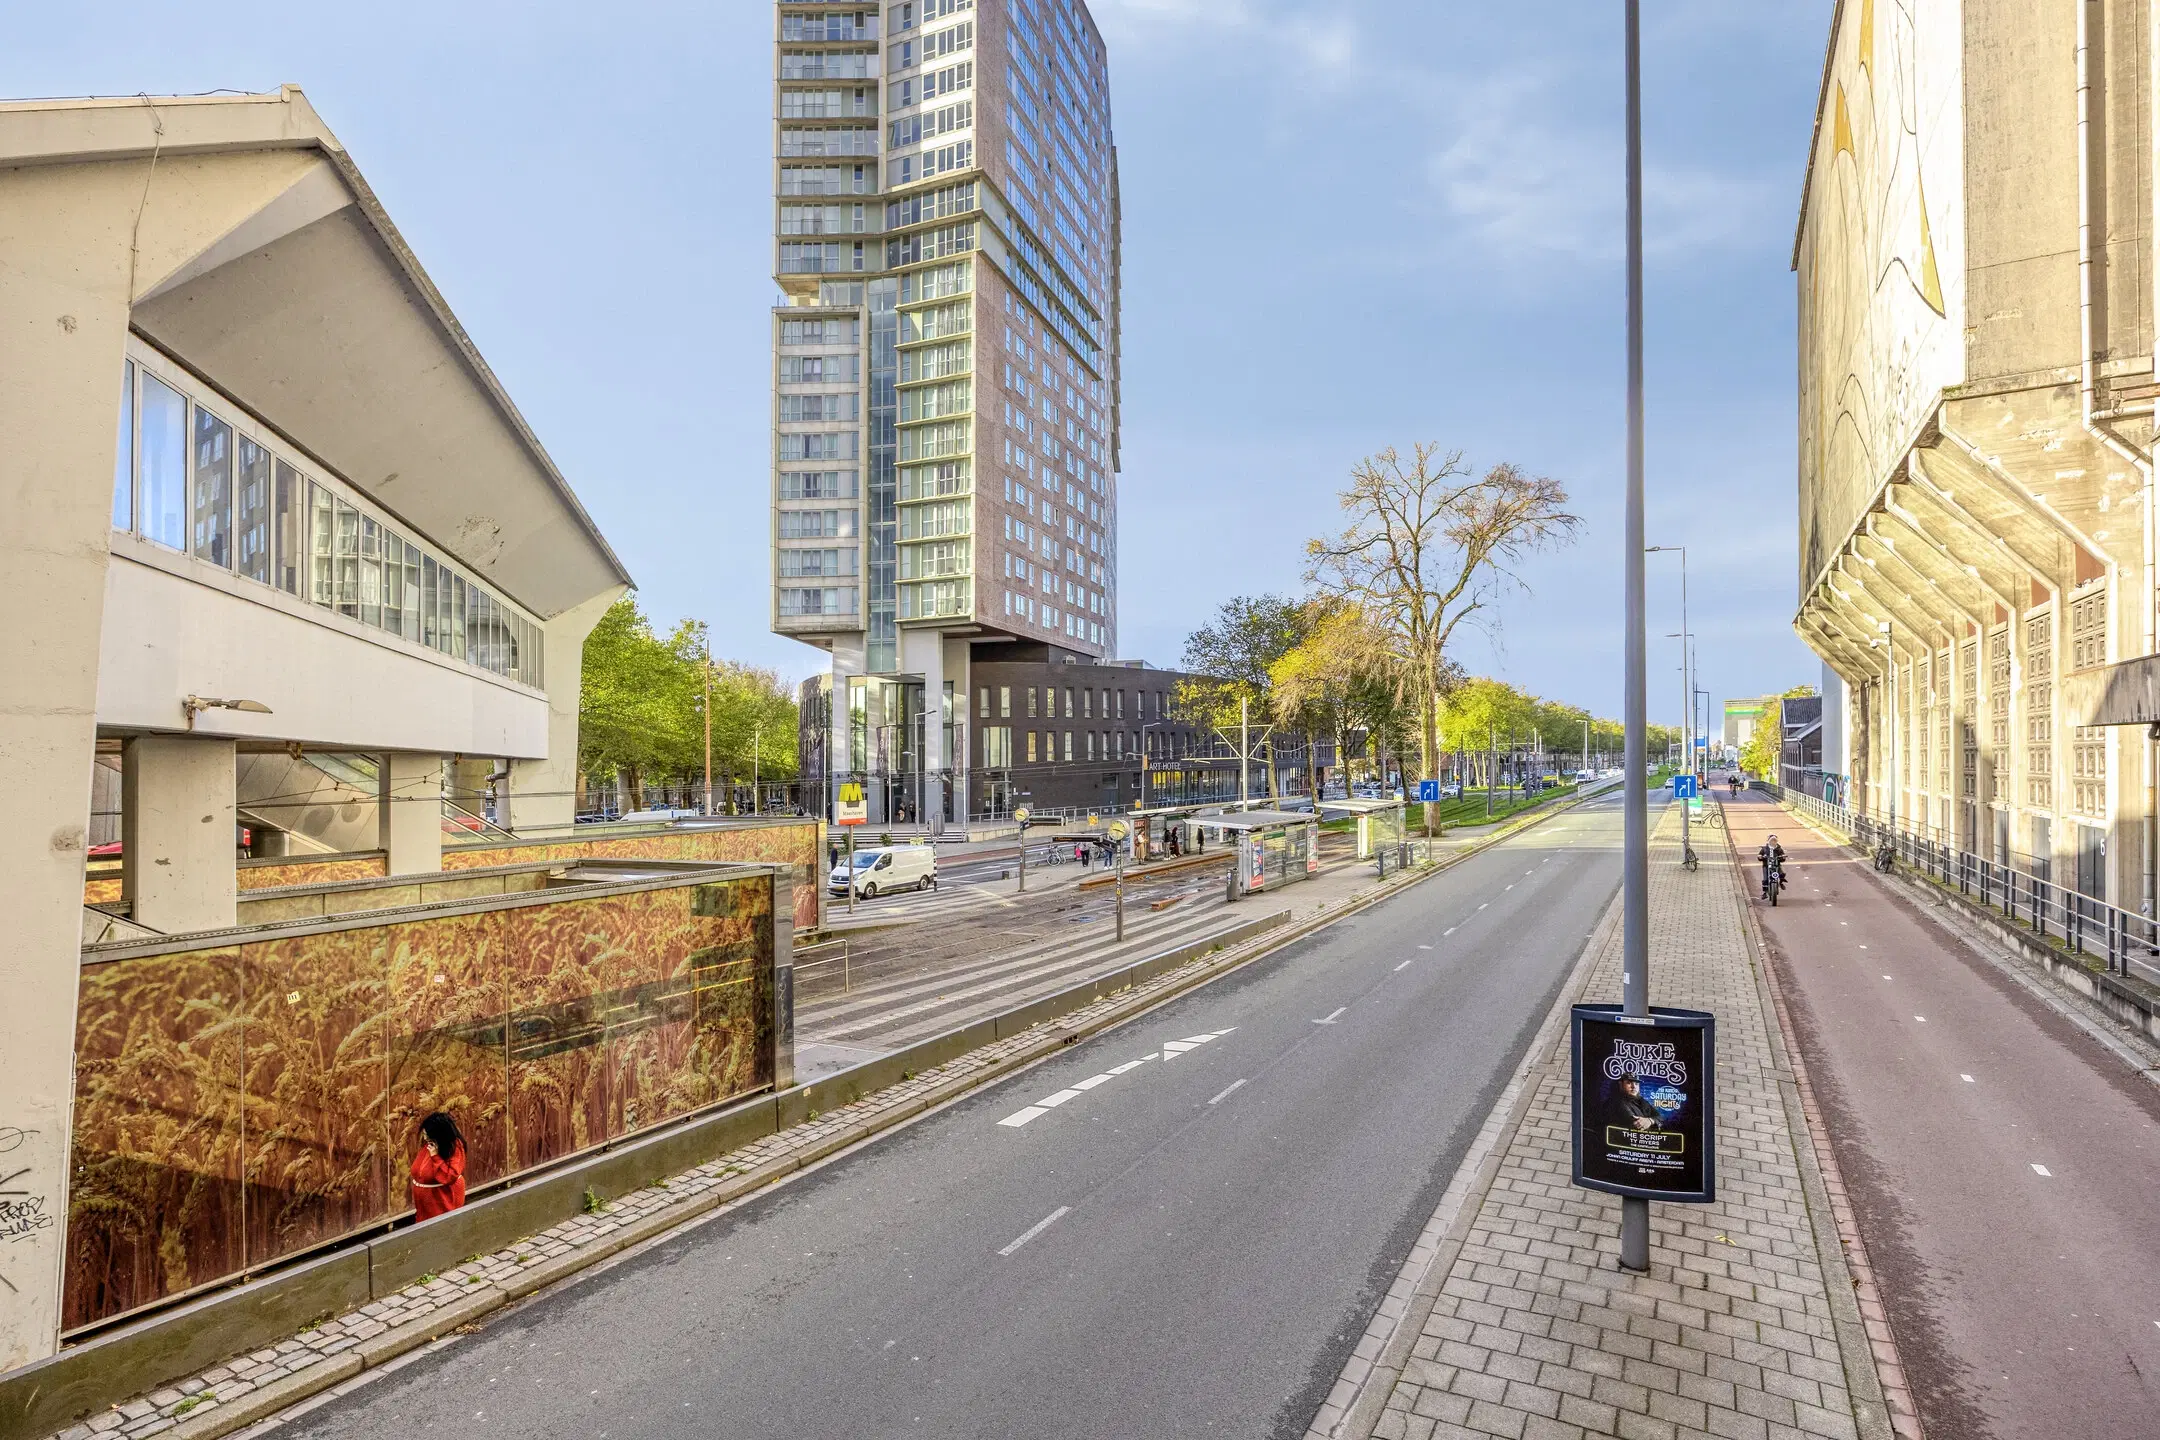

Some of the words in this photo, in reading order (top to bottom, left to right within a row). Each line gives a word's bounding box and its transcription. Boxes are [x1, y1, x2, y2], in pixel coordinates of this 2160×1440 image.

[1149, 762, 1161, 770] ART
[2100, 838, 2105, 856] 6
[1614, 1039, 1675, 1061] LUKE
[1603, 1056, 1687, 1085] COMBS
[1650, 1092, 1687, 1101] SATURDAY
[1639, 1133, 1667, 1141] SCRIPT
[1619, 1150, 1649, 1158] SATURDAY
